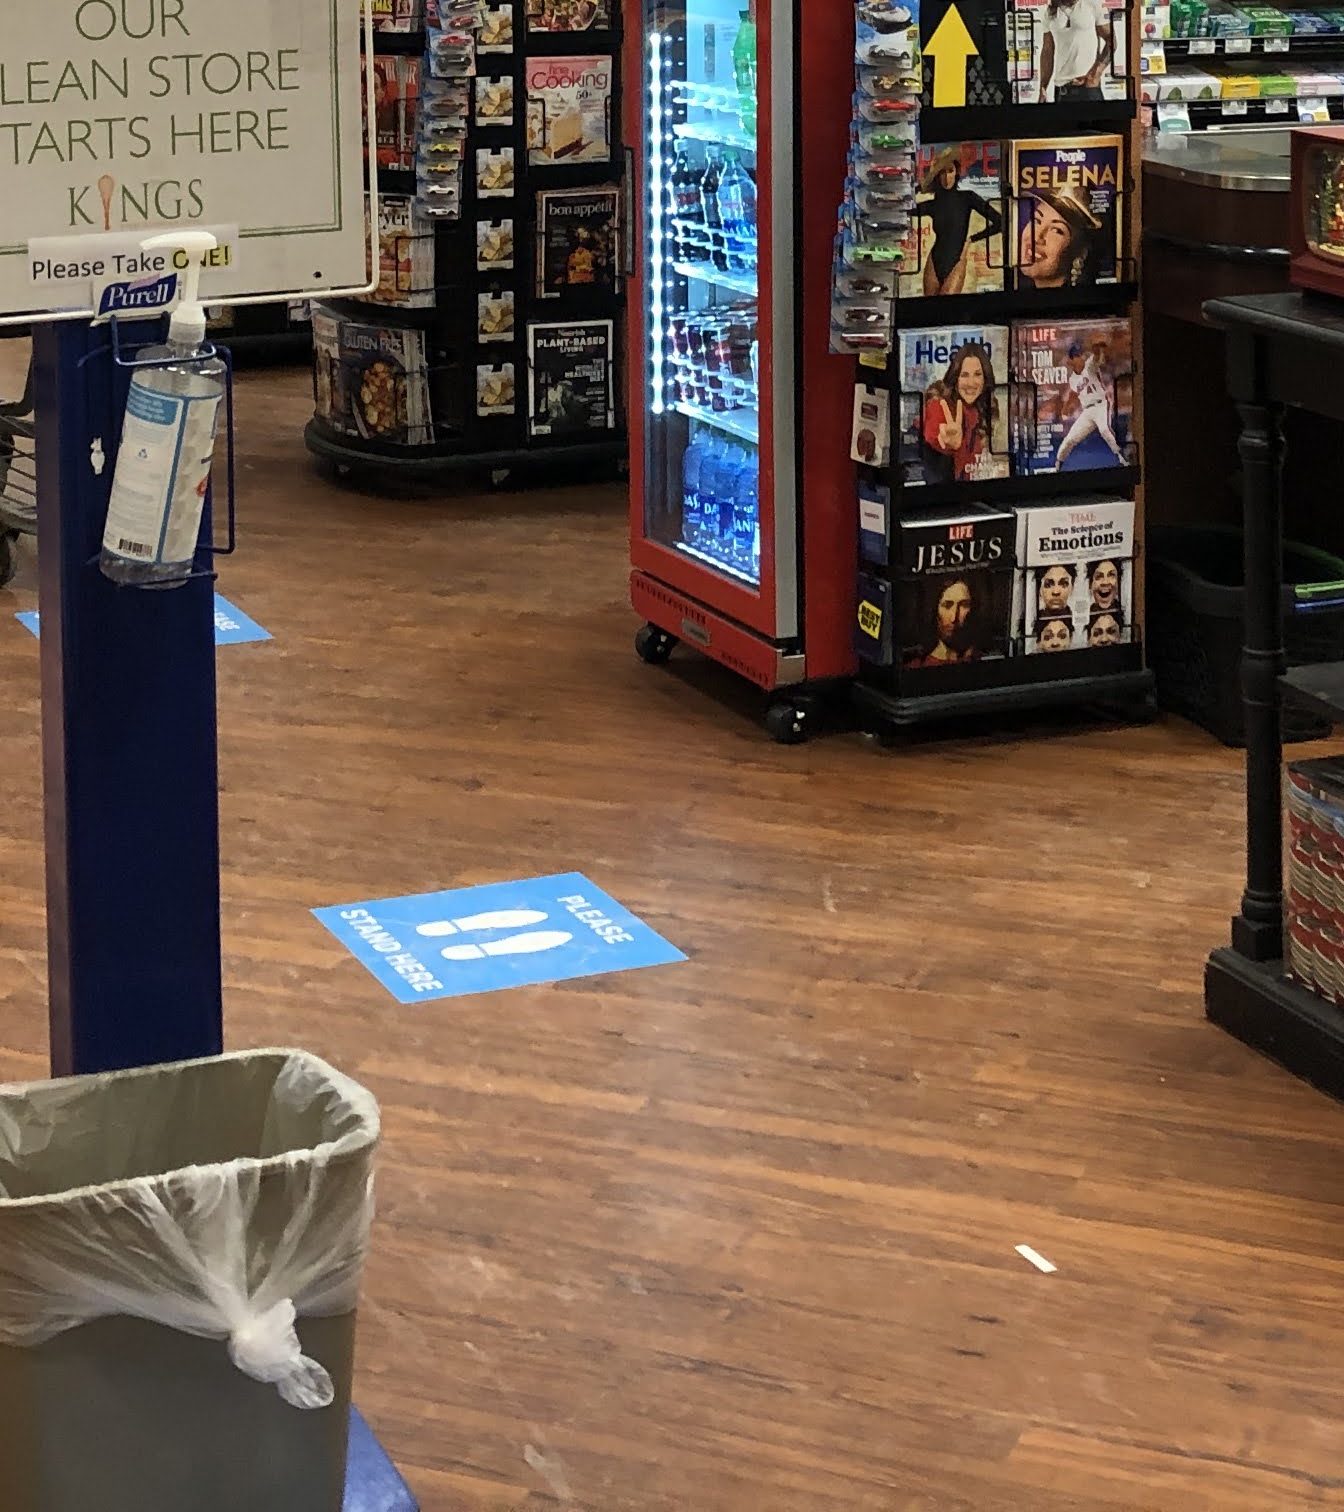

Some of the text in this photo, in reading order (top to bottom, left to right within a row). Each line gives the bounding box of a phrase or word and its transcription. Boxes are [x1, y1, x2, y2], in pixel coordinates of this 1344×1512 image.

[148, 49, 300, 98] STORE
[531, 71, 608, 89] Cooking
[170, 108, 290, 155] HERE
[918, 142, 999, 182] HPE
[1056, 149, 1087, 165] People
[1021, 163, 1116, 188] SELENA
[68, 175, 204, 230] KINGS
[549, 203, 572, 215] bon
[32, 259, 105, 280] Please
[112, 252, 165, 274] Take
[108, 282, 169, 307] Purell
[537, 336, 606, 348] PLANT-BASED
[1032, 329, 1056, 342] LIFE
[1032, 350, 1053, 366] TOM
[1031, 366, 1068, 385] SEAVER
[1068, 512, 1096, 524] TIME
[949, 524, 974, 540] LIFE
[1051, 526, 1068, 536] The
[1070, 523, 1100, 535] Science
[1038, 530, 1123, 552] Emotions
[911, 537, 1003, 574] JESUS
[557, 894, 634, 945] PLEASE
[339, 908, 444, 993] STAND HERE
